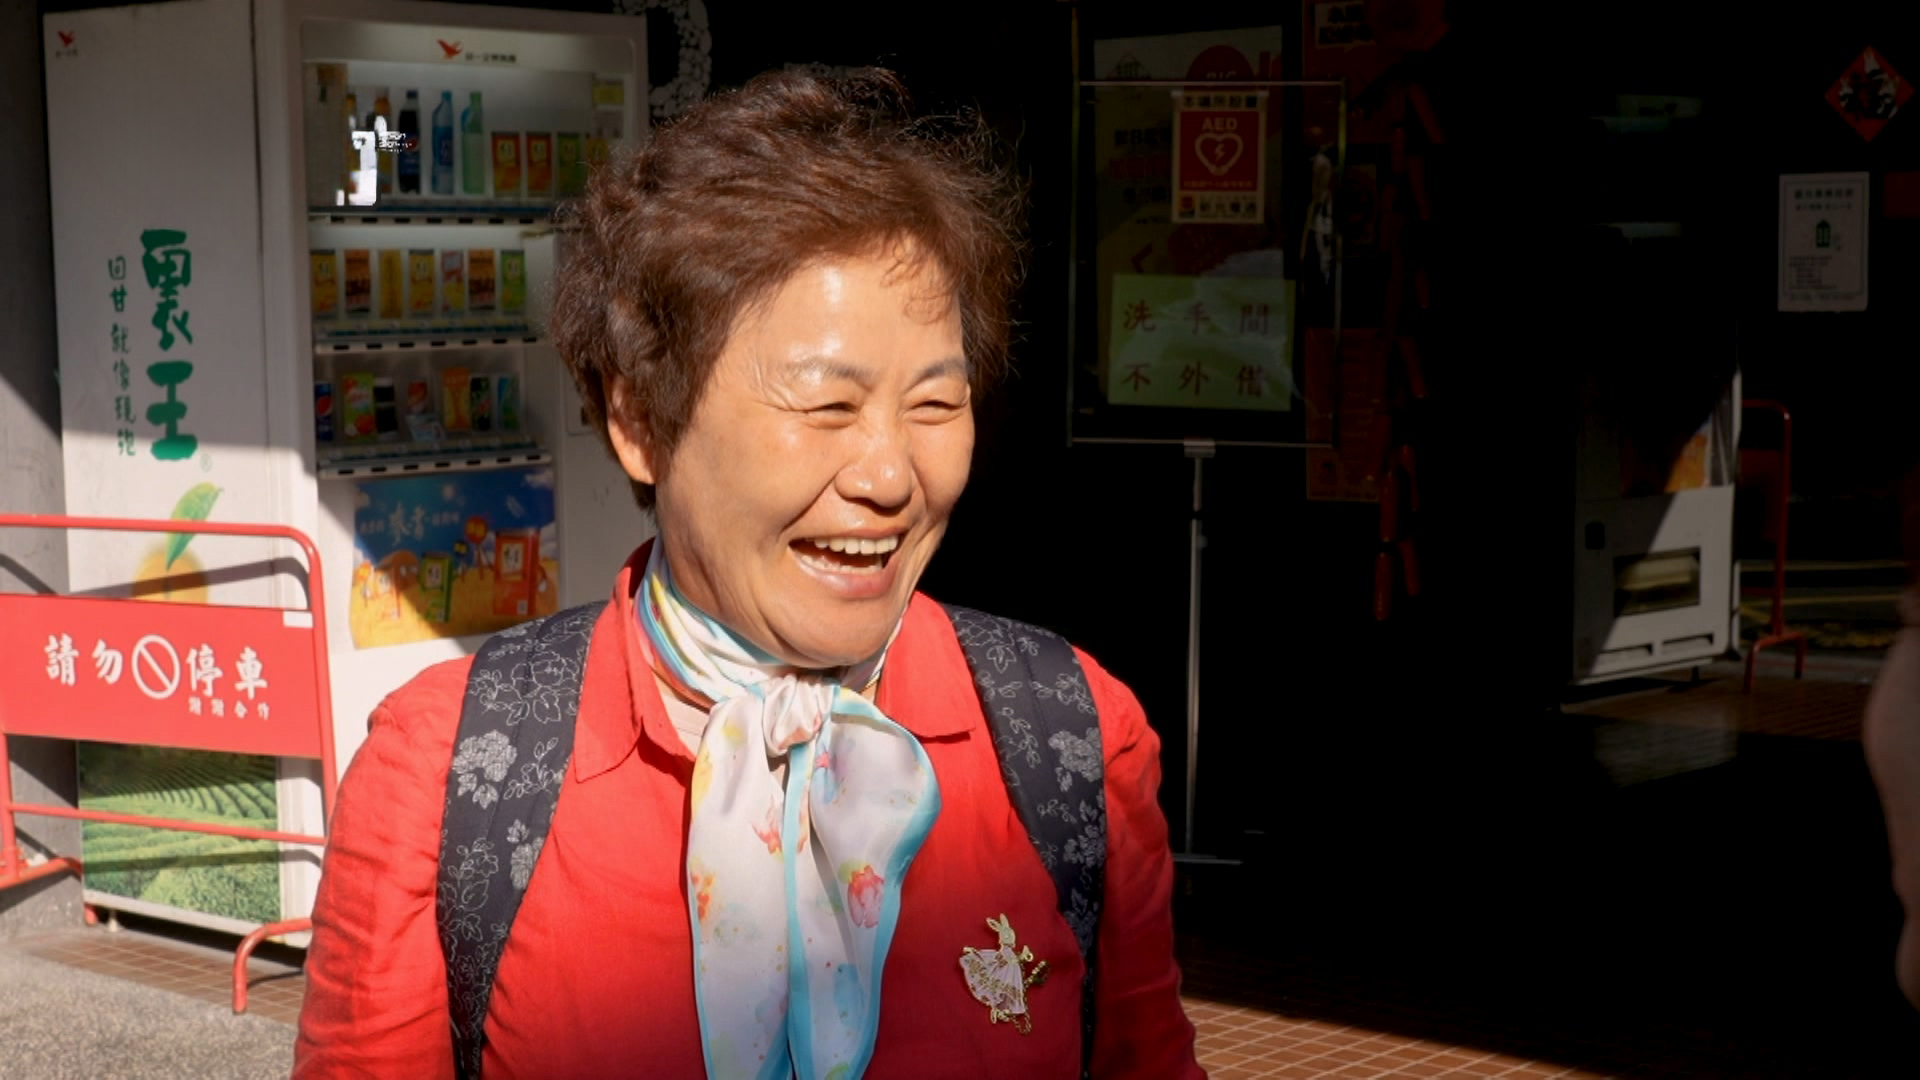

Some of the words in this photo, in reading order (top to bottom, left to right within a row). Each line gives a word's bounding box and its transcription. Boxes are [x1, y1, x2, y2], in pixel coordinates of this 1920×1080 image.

[1201, 117, 1238, 131] AED
[1123, 299, 1269, 336] 洗手間
[1121, 362, 1264, 398] 不外借
[188, 696, 270, 720] 謝謝合作
